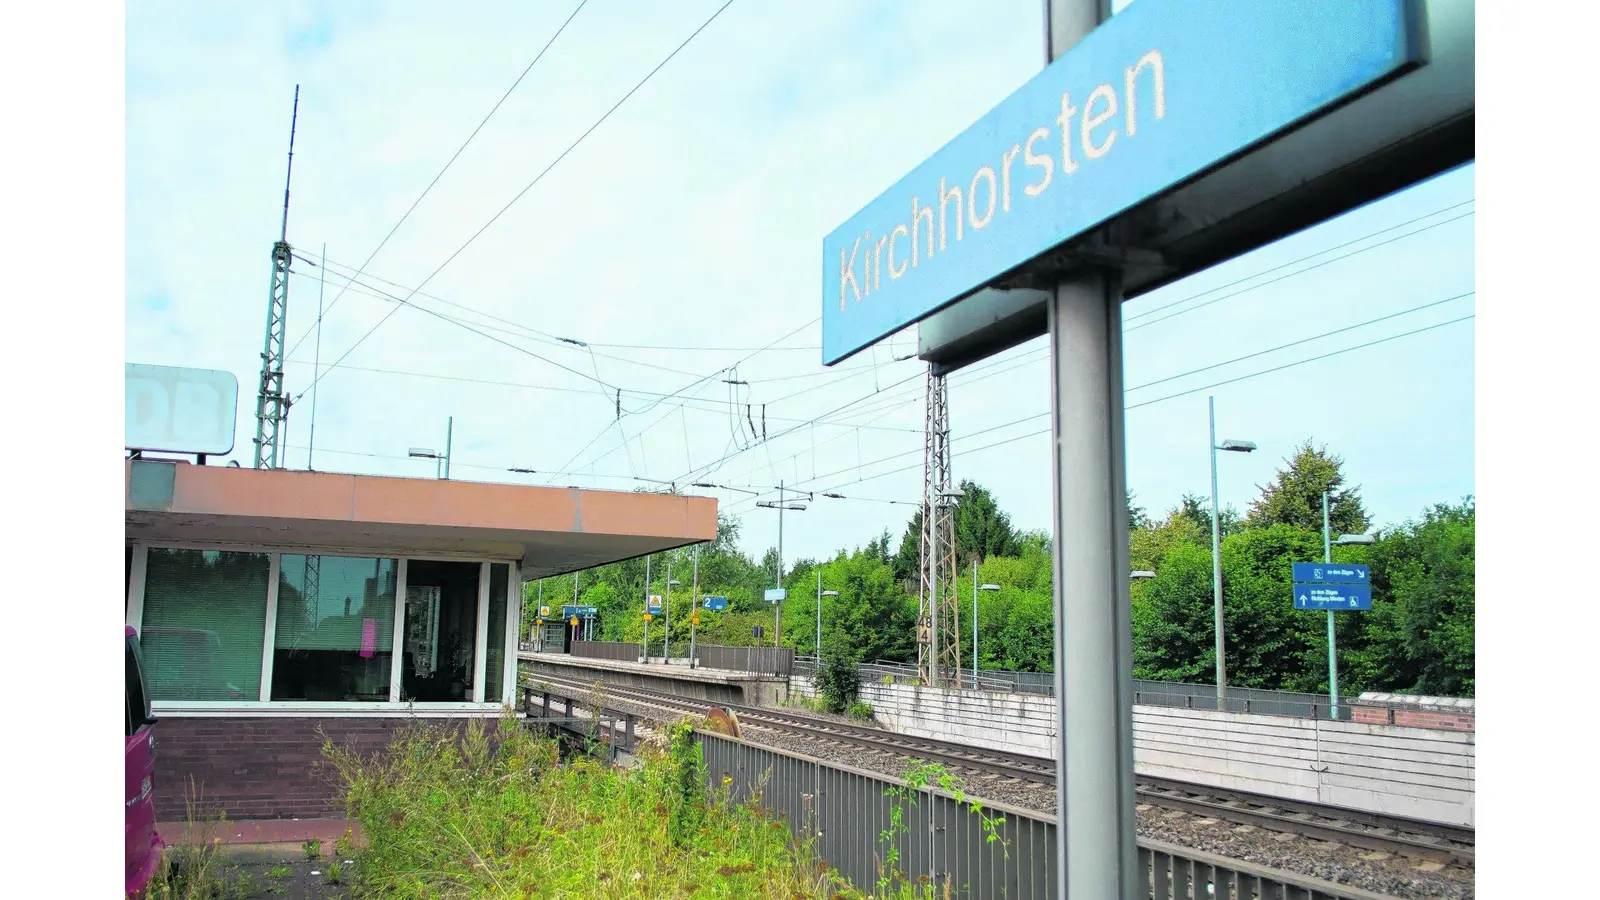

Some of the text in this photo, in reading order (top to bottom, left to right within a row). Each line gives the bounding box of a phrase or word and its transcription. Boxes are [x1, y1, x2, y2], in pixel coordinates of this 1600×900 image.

[838, 48, 1166, 312] Kirchhorsten
[704, 598, 711, 607] 2
[917, 617, 932, 628] 48
[921, 629, 928, 638] 4
